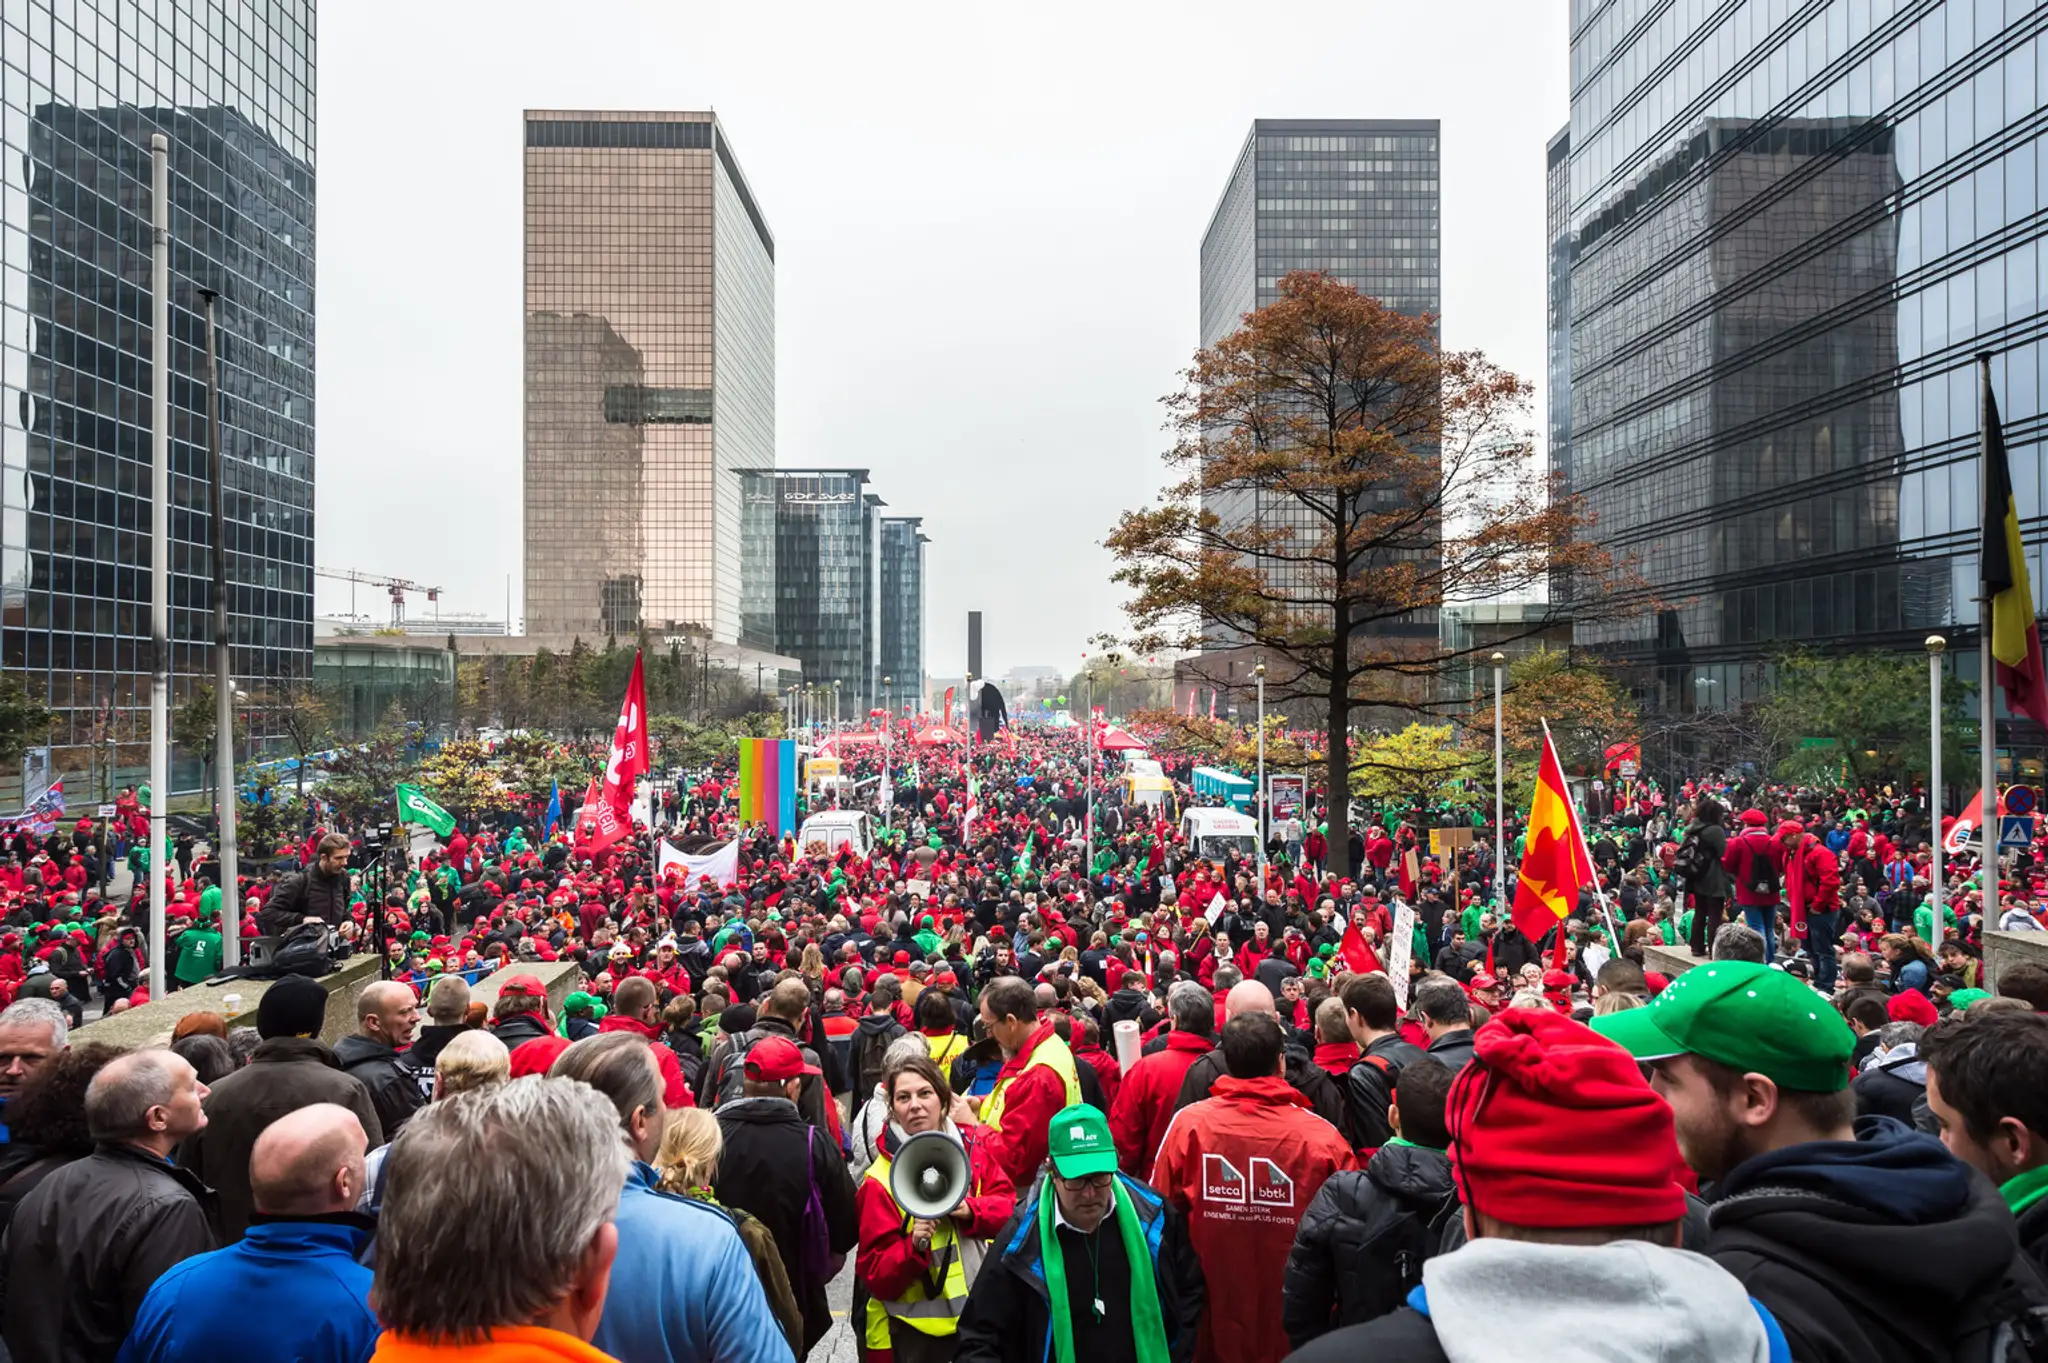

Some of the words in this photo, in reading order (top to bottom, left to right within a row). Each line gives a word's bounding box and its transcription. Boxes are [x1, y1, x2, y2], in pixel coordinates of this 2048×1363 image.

[664, 635, 686, 645] WTC
[1208, 1185, 1240, 1196] setca
[1259, 1187, 1286, 1199] bbtk
[1225, 1204, 1248, 1213] SAMEN
[1250, 1206, 1271, 1214] STERK
[1203, 1210, 1236, 1220] ENSEMBLE
[1254, 1214, 1271, 1222] PLUS
[1272, 1216, 1295, 1225] FORTS
